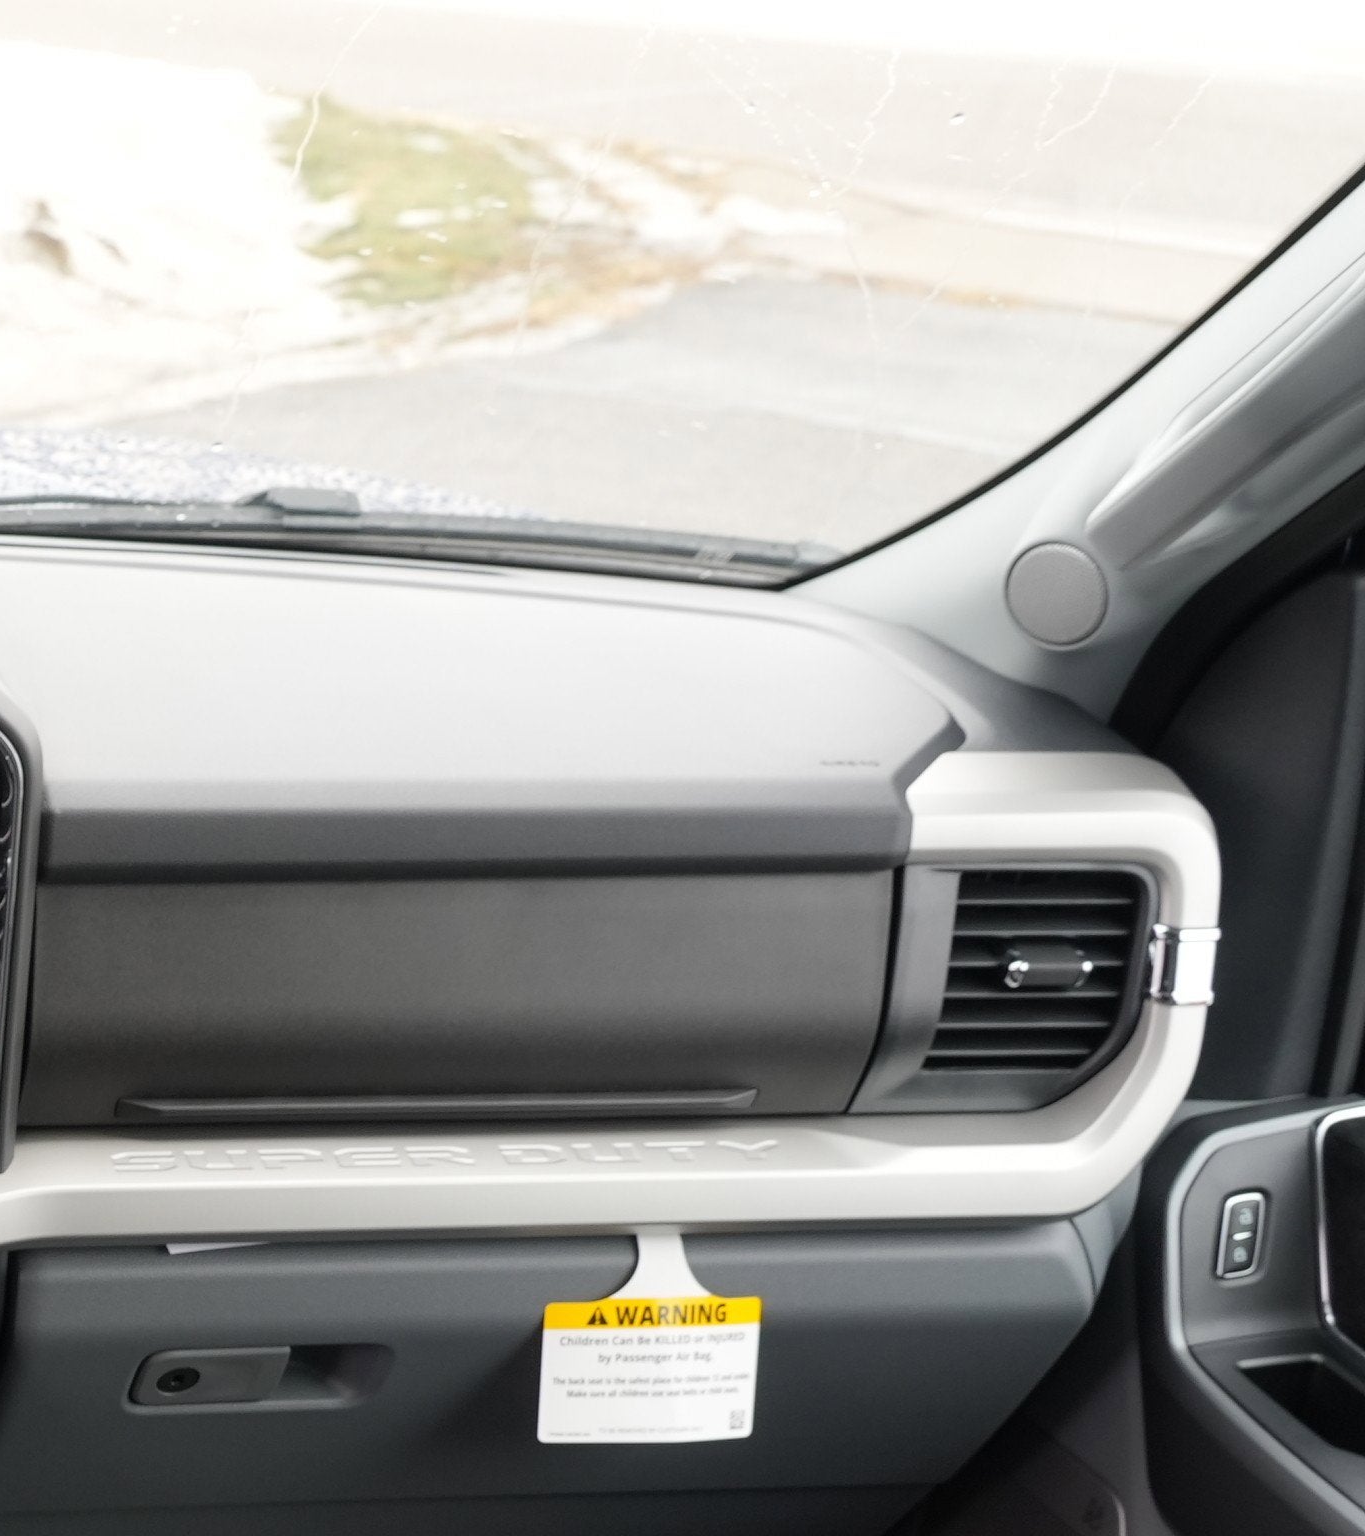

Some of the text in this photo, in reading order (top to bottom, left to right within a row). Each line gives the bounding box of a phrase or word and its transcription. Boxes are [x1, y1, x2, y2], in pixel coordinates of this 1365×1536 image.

[109, 1138, 780, 1173] SUPER DUTY
[616, 1304, 728, 1326] WARNING
[559, 1336, 609, 1346] Children
[612, 1336, 633, 1345] Can
[637, 1336, 651, 1345] Be
[655, 1335, 690, 1344] KILLED
[598, 1353, 611, 1365] by
[615, 1353, 672, 1364] Passenger
[676, 1352, 690, 1361] Air
